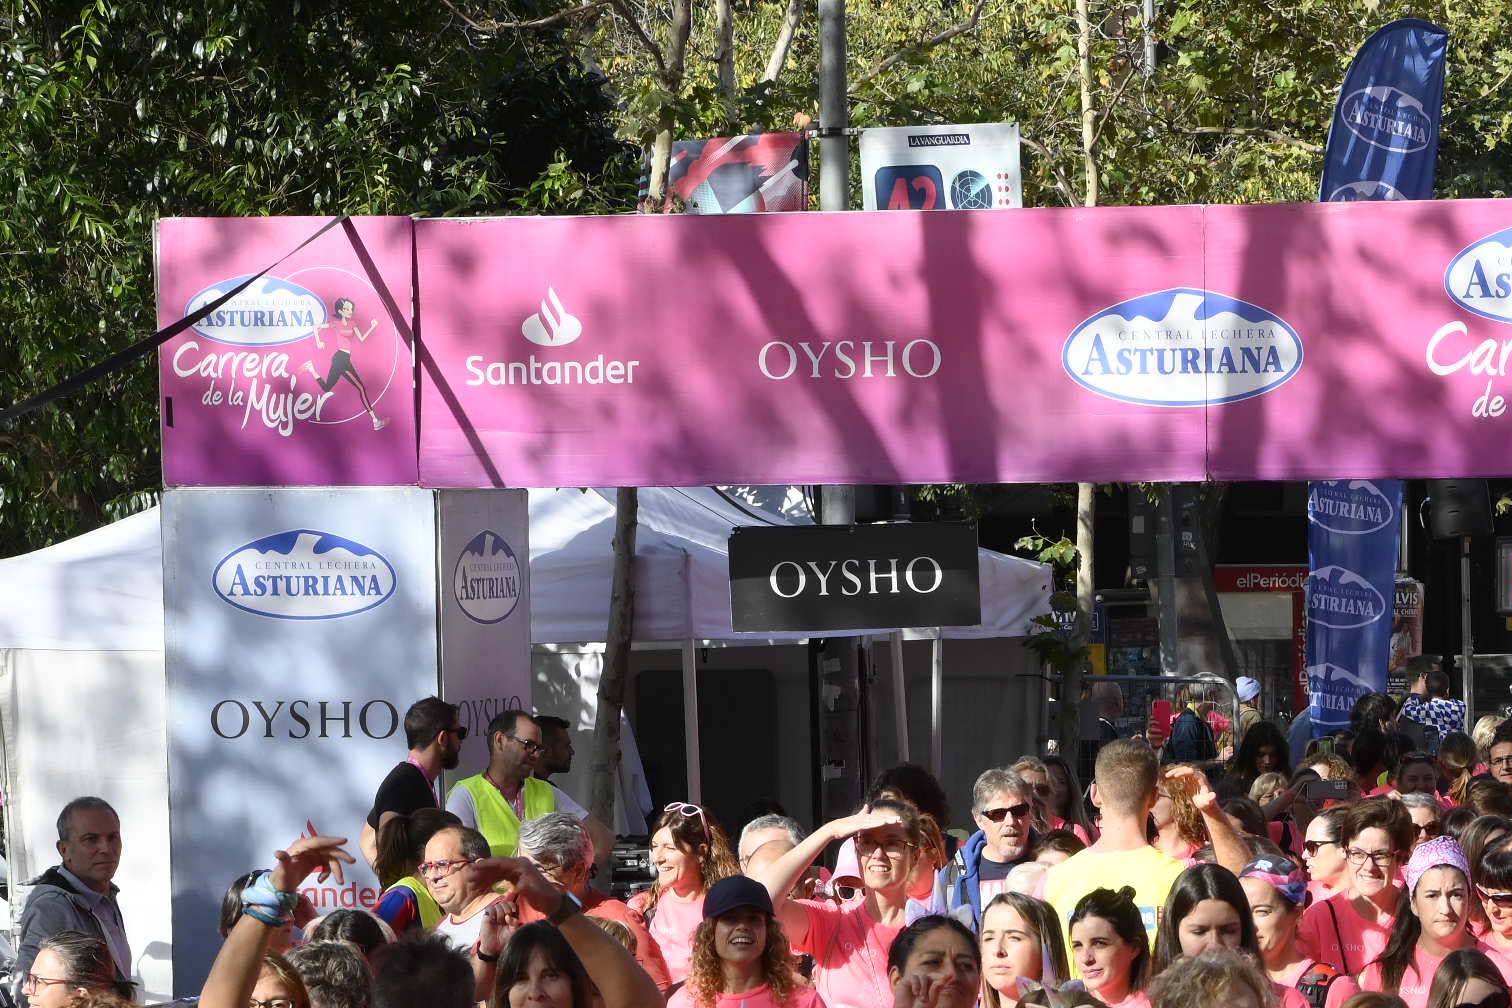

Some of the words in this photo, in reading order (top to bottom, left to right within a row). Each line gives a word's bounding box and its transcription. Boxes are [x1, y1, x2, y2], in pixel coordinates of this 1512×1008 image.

[197, 299, 316, 328] ASTURIANA
[1118, 329, 1193, 341] CENTRAL
[1200, 328, 1276, 340] LECHERA
[172, 340, 290, 379] Carrera
[465, 353, 640, 387] Santander
[758, 339, 942, 380] OYSHO
[1081, 333, 1285, 376] ASTURIANA
[202, 379, 223, 407] de
[227, 379, 244, 406] la
[241, 375, 334, 437] Mujer
[1471, 379, 1507, 418] de
[227, 563, 384, 598] ASTURIANA
[255, 561, 313, 571] CENTRAL
[318, 560, 377, 571] LECHERA
[460, 565, 517, 602] ASTURIANA
[768, 556, 943, 598] OYSHO
[210, 698, 400, 741] OYSHO
[302, 881, 385, 910] ande
